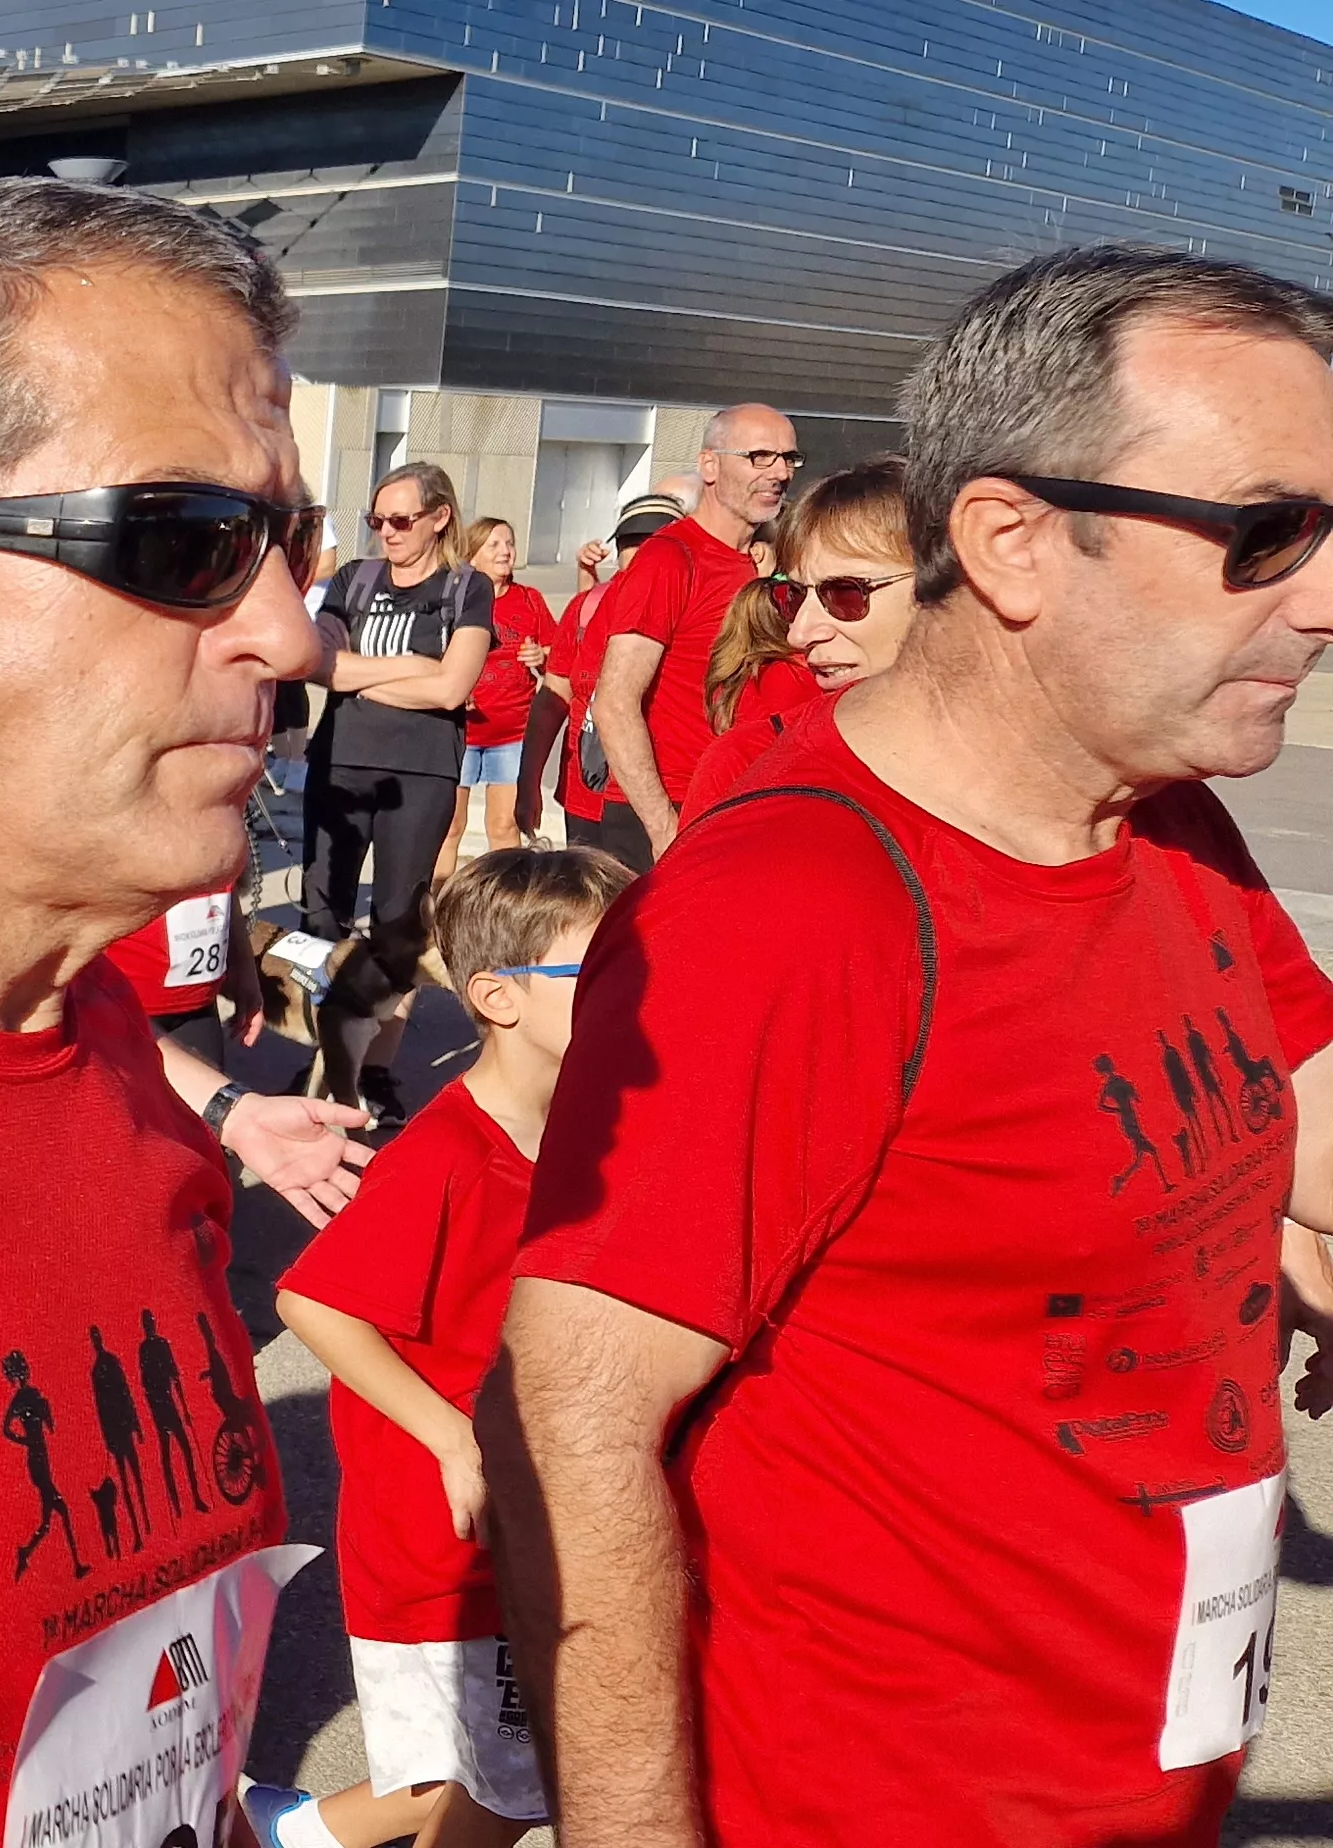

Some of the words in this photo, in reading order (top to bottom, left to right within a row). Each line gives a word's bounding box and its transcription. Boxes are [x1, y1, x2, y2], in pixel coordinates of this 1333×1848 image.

[1196, 1589, 1236, 1625] MARCHA
[28, 1791, 90, 1848] MARCHA
[92, 1758, 154, 1825] SOLIDARIA
